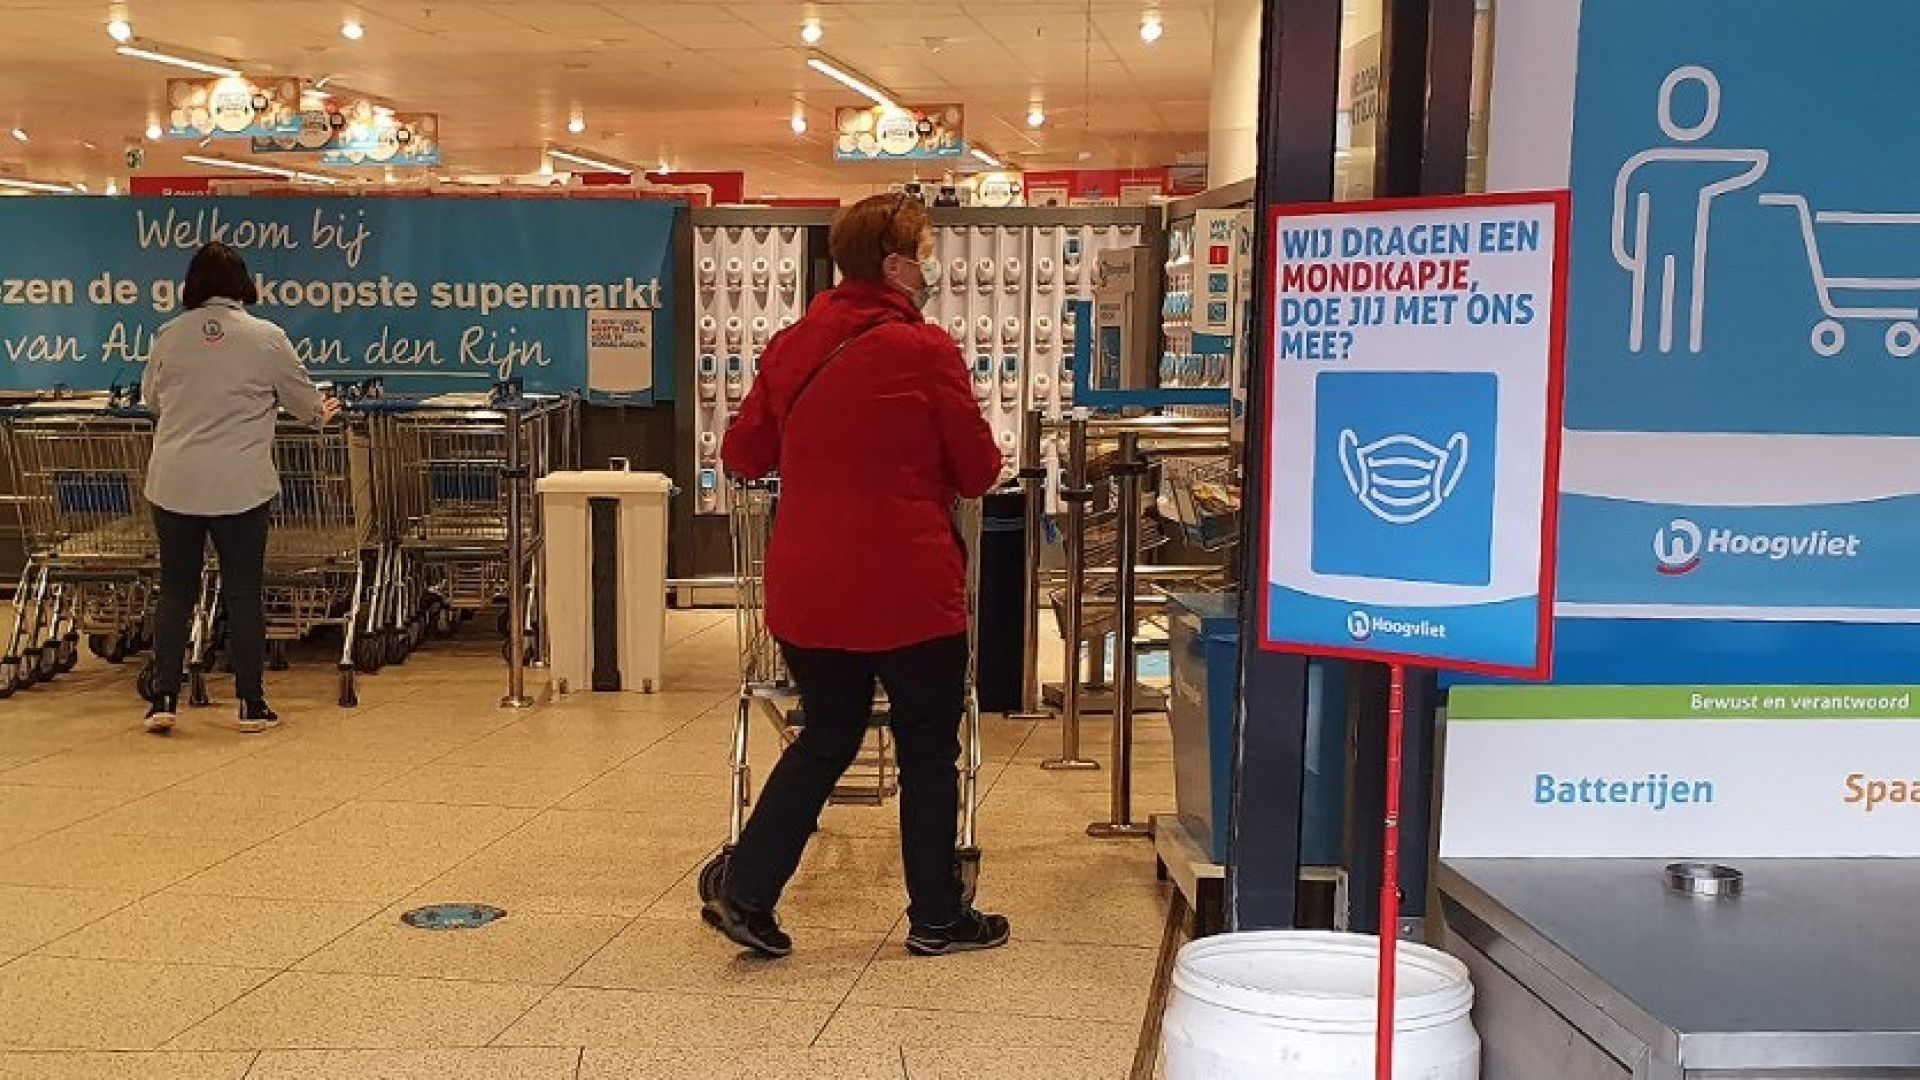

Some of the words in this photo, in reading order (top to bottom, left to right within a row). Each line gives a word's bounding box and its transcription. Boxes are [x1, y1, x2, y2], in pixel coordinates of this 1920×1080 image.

[137, 207, 298, 249] Welkom
[312, 208, 370, 268] bij
[1282, 229, 1332, 258] WIJ
[1341, 222, 1468, 256] DRAGEN
[1479, 220, 1539, 252] EEN
[1281, 260, 1479, 292] MONDKAPJE,
[0, 279, 73, 304] zen
[88, 271, 138, 304] de
[152, 272, 417, 313] gkoopste
[430, 277, 662, 315] supermarkt
[1280, 298, 1341, 327] DOE
[1348, 297, 1383, 325] JIJ
[1394, 296, 1458, 325] MET
[1467, 294, 1534, 324] ONS
[4, 335, 87, 362] van
[296, 335, 350, 364] an
[364, 326, 444, 365] den
[460, 325, 552, 380] Rijn
[1280, 331, 1353, 359] MEE?
[1707, 528, 1861, 560] Hoogvliet
[1372, 617, 1446, 638] Hoogvliet
[1691, 693, 1758, 710] Bewust
[1763, 696, 1786, 709] en
[1790, 693, 1910, 710] verantwoord
[1535, 775, 1713, 810] Batterijen
